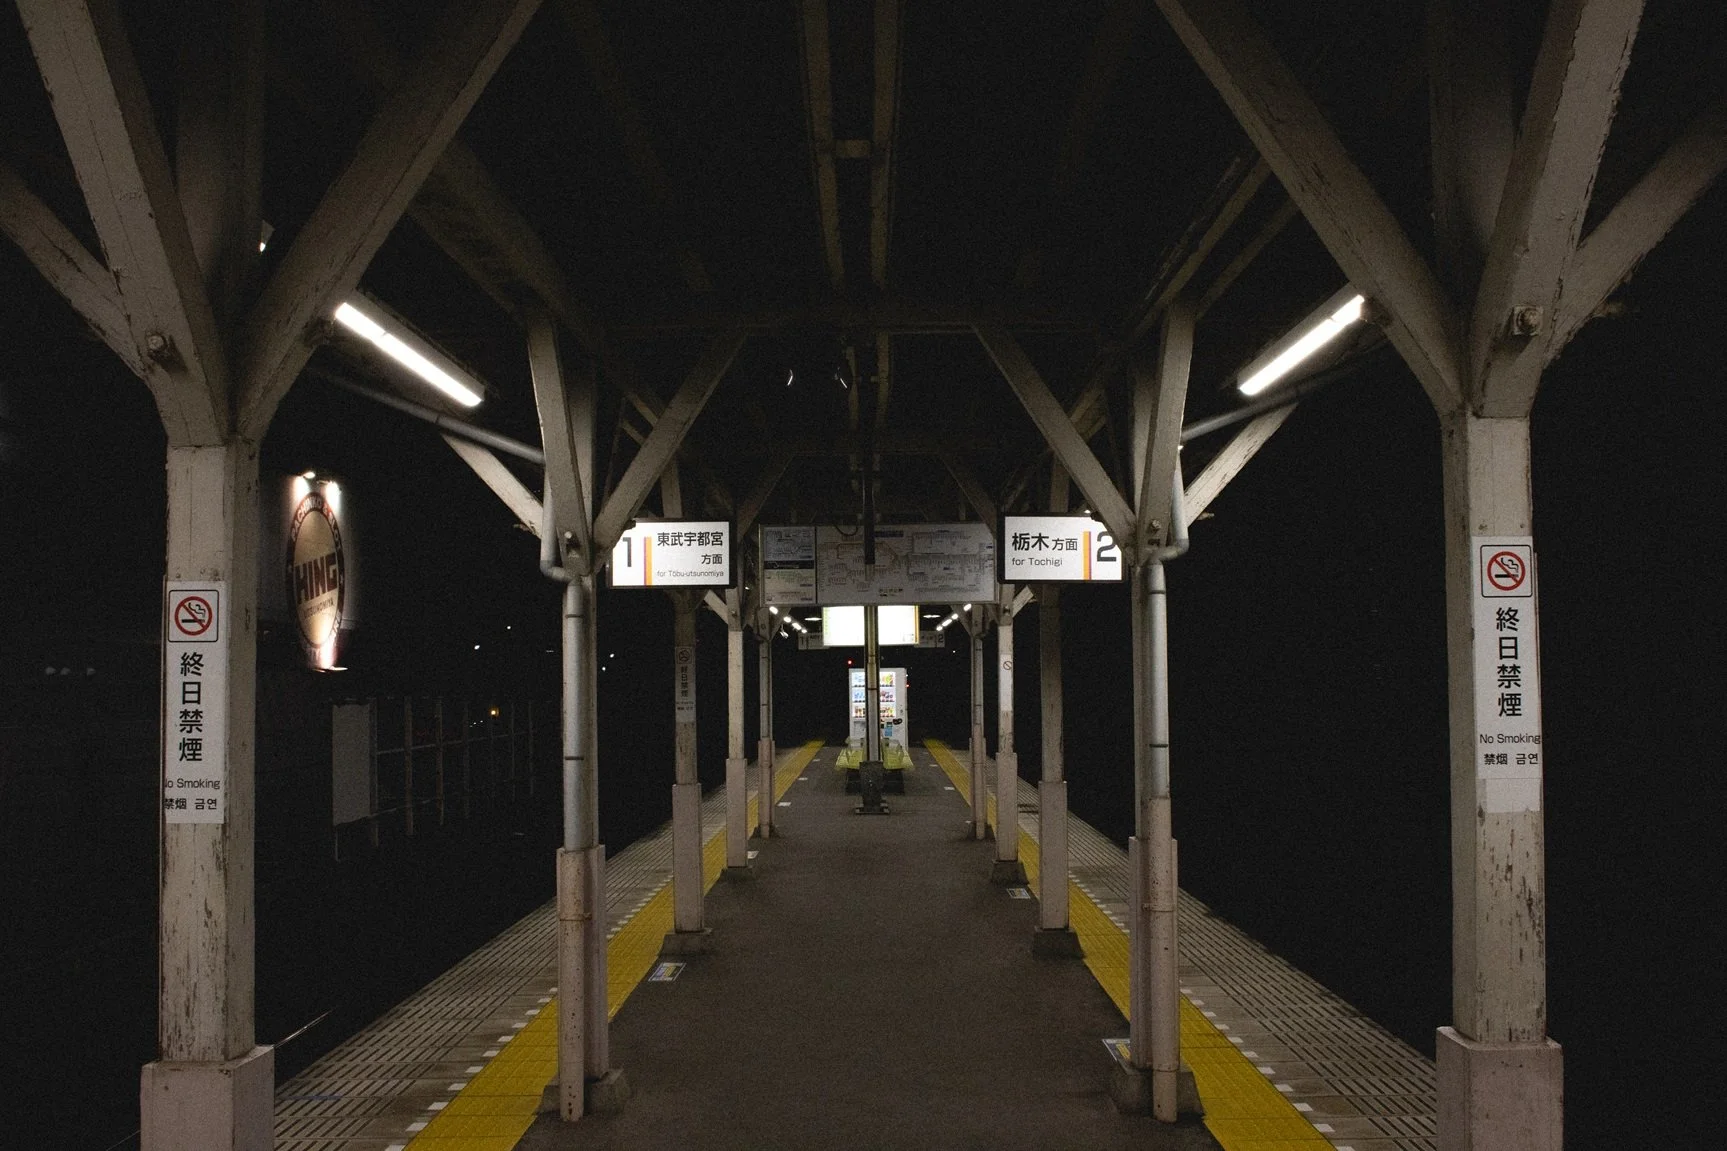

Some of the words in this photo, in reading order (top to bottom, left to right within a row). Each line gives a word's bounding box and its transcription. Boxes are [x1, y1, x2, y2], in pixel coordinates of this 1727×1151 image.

[657, 532, 723, 547] 東武宇都宮
[622, 537, 632, 567] 1
[1097, 531, 1117, 562] 2
[701, 554, 723, 565] 方面
[1012, 557, 1025, 566] for
[1028, 557, 1062, 567] Tochigi
[1496, 606, 1523, 718] 終日禁煙
[178, 652, 204, 762] 終日禁煙
[1479, 733, 1494, 744] No
[1497, 733, 1541, 745] Smoking
[1484, 753, 1508, 765] 禁烟
[1515, 753, 1539, 765] 금연
[177, 778, 221, 790] Smoking
[194, 798, 217, 810] 금연
